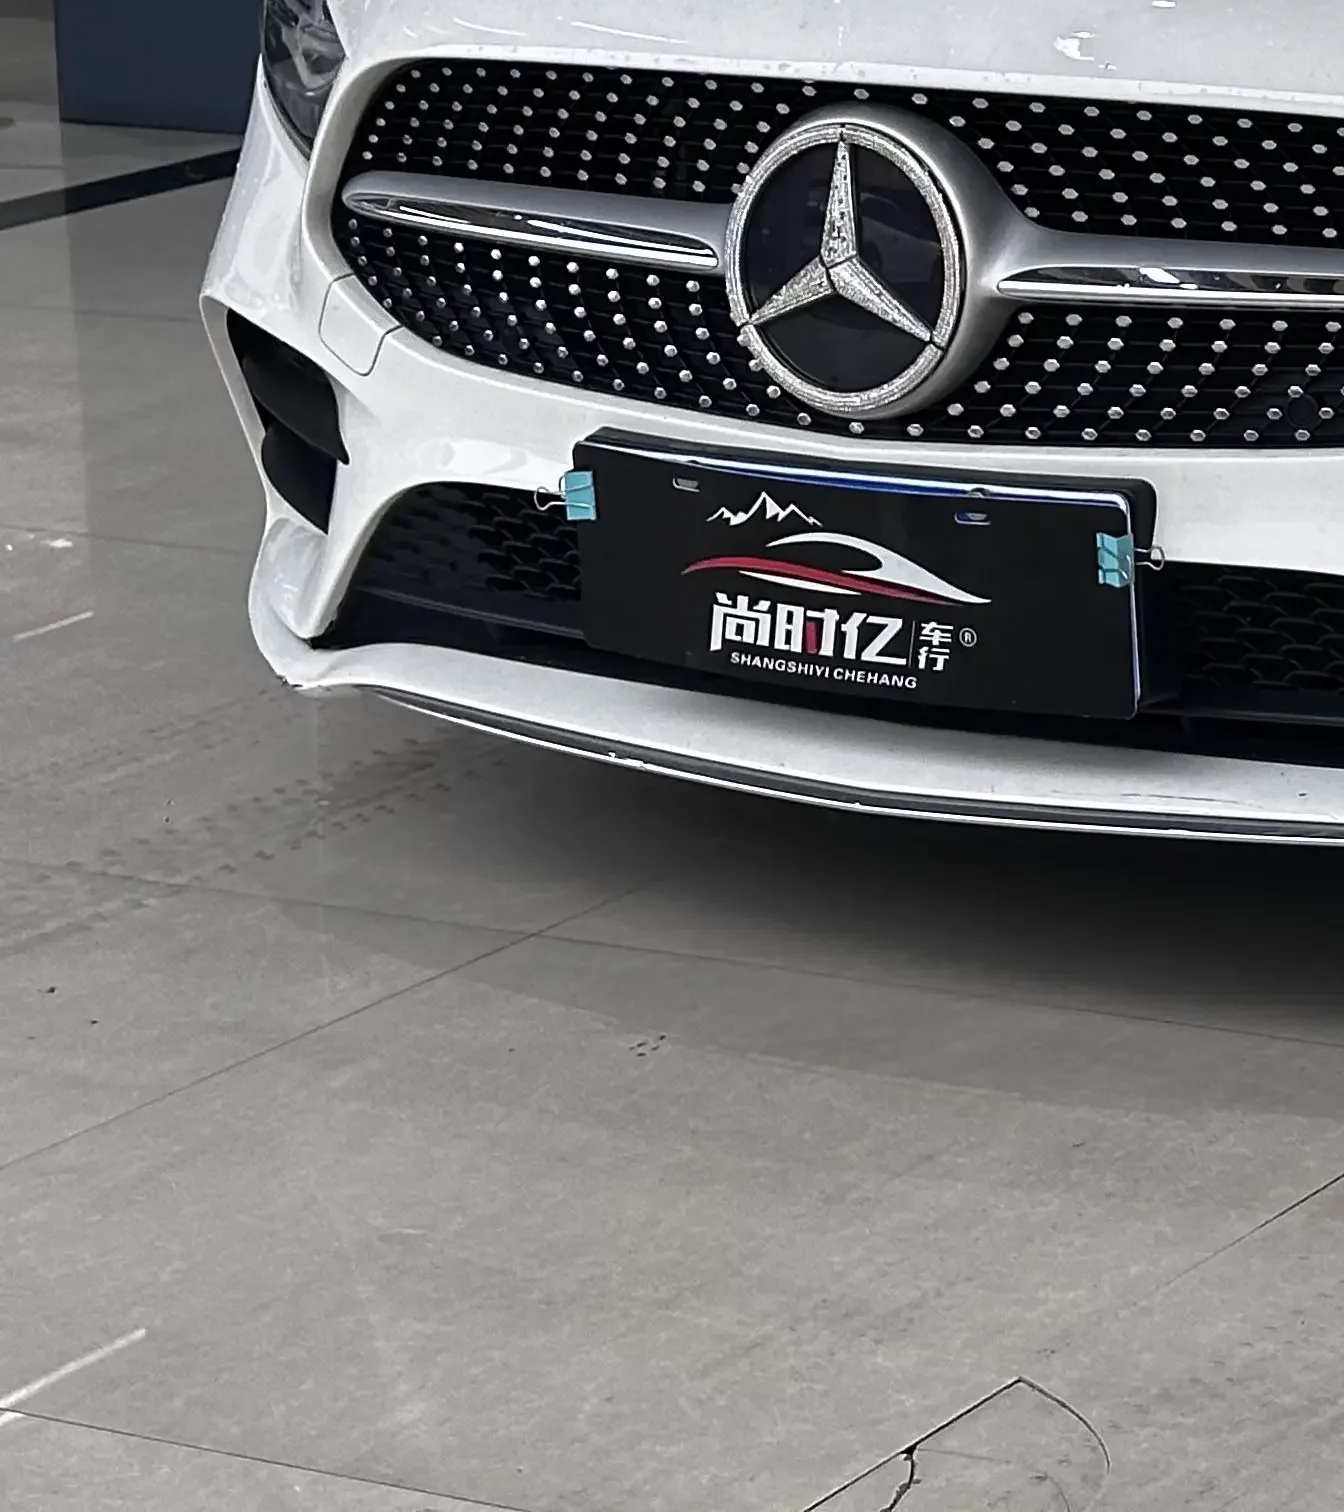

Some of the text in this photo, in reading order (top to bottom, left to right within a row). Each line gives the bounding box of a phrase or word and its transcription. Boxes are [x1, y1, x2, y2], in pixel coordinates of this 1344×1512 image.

[710, 592, 907, 665] 尚时亿
[729, 652, 918, 689] SHANGSHIYI CHEHANG
